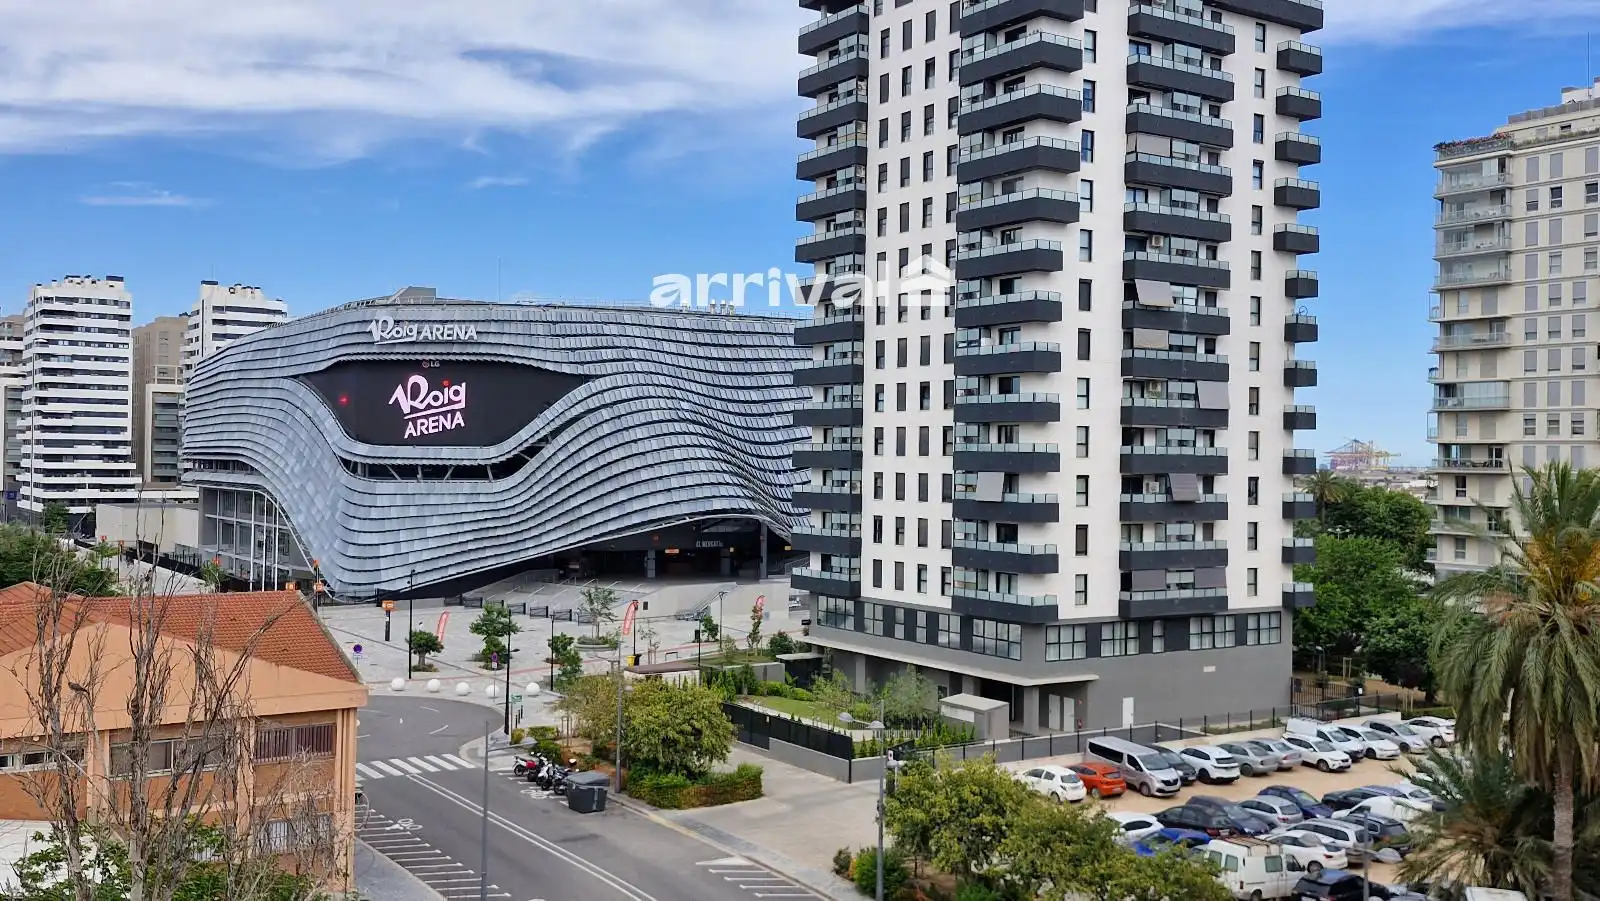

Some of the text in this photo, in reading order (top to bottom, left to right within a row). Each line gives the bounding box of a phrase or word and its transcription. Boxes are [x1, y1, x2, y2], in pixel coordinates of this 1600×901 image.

[367, 315, 478, 345] Roig ARENA
[388, 374, 466, 420] Roig
[404, 411, 465, 439] ARENA
